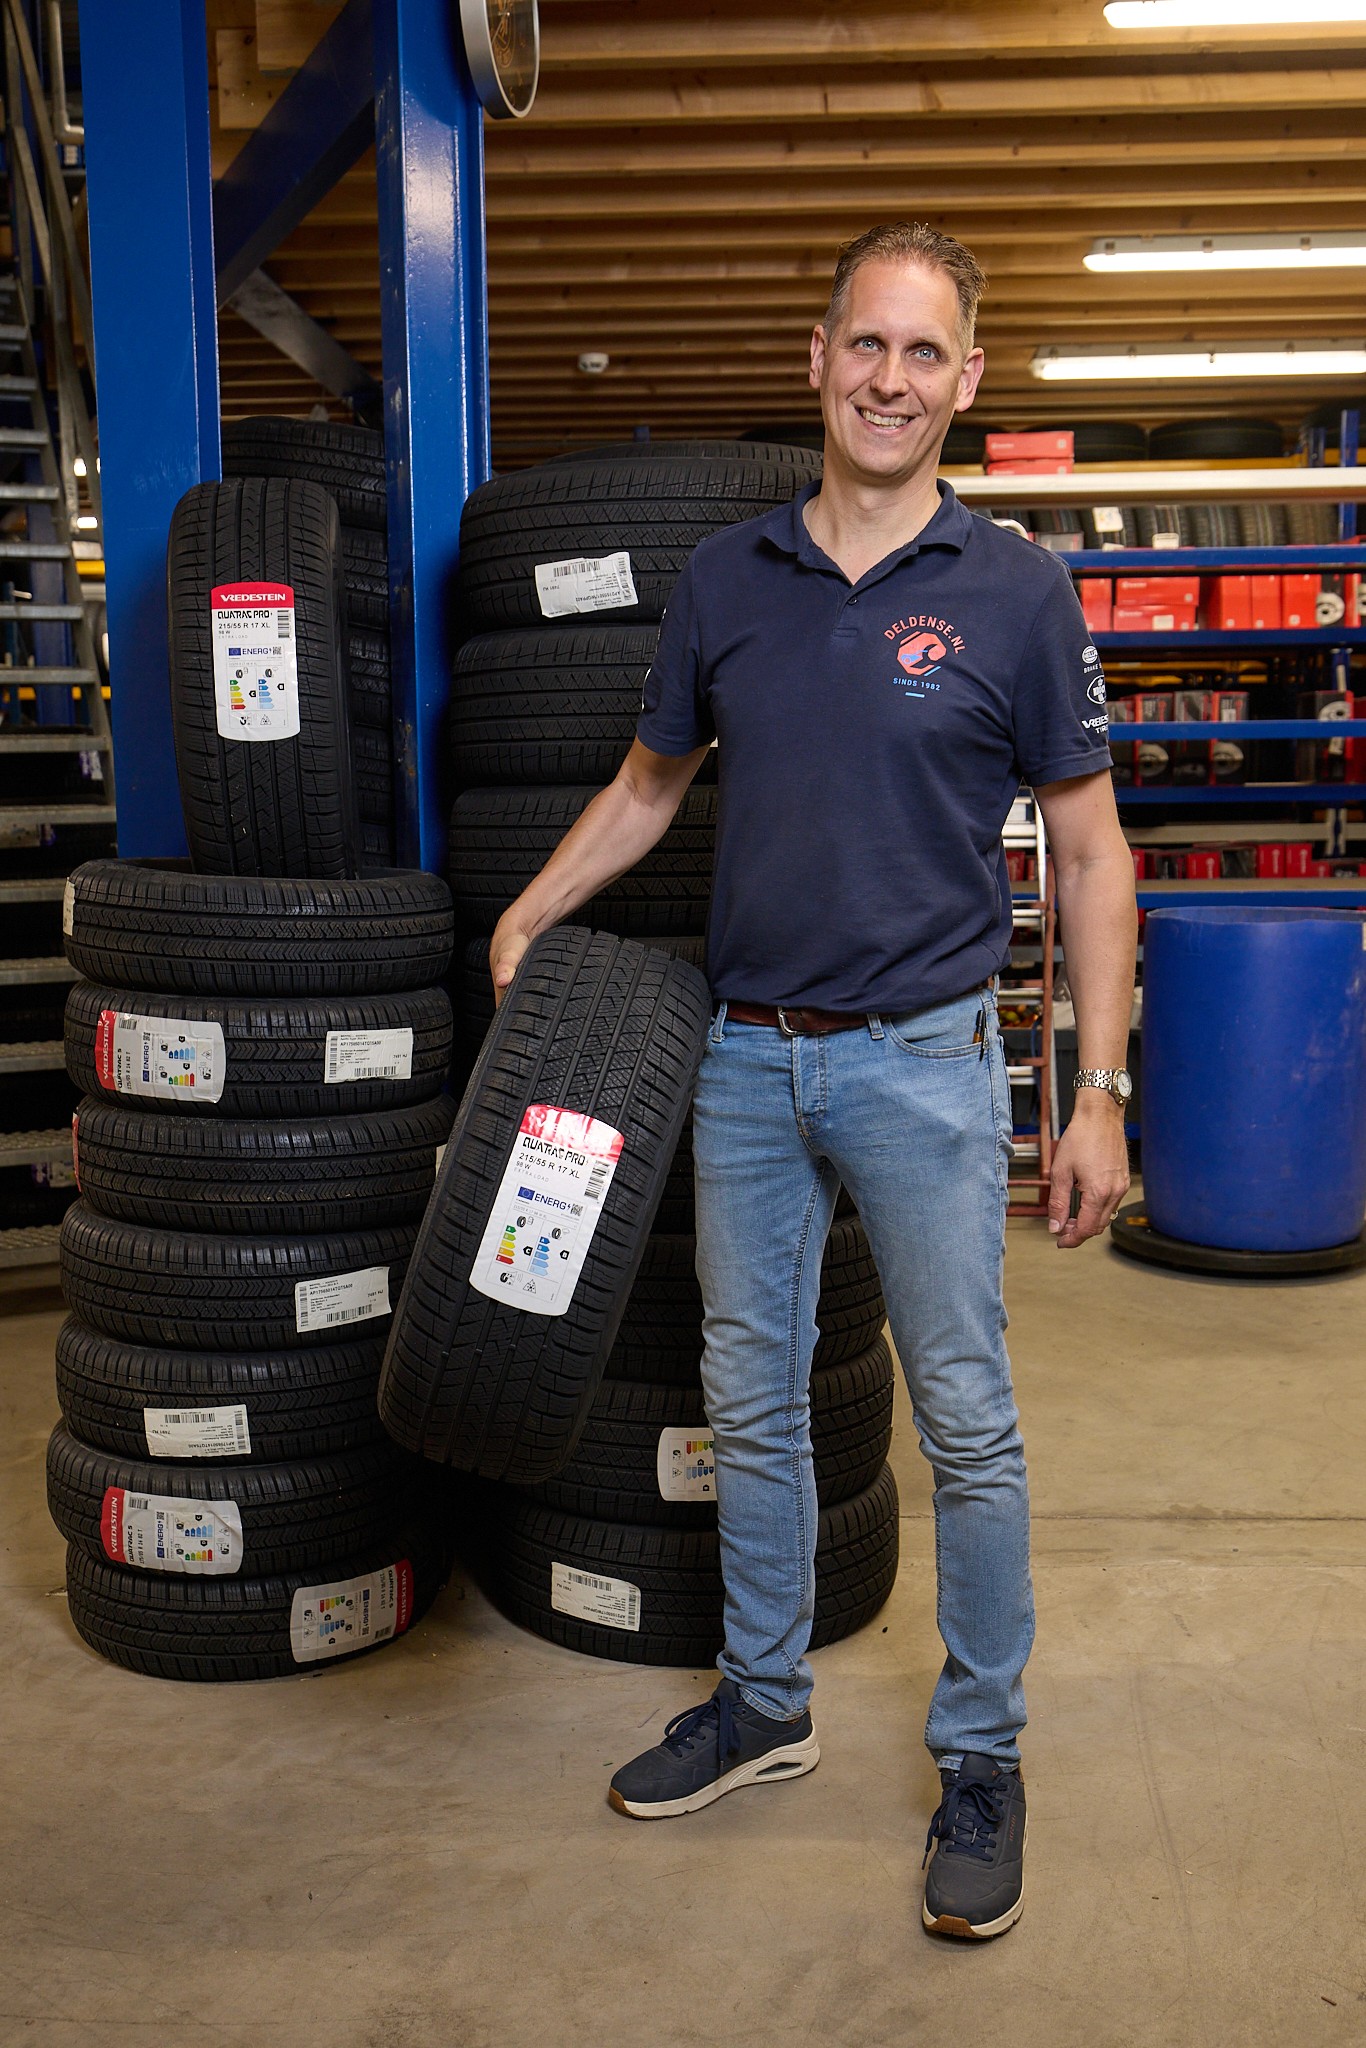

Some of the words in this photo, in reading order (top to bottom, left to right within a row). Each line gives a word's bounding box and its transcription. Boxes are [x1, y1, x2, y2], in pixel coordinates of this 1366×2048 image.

[220, 593, 286, 602] VREDESTEIN
[218, 610, 252, 619] QUATRAC
[884, 616, 966, 655] DELDENSE.NL
[1084, 664, 1098, 673] BRAKE
[893, 678, 917, 686] SINDS
[921, 682, 940, 691] 1982
[523, 1137, 564, 1159] QUATRAC
[519, 1153, 546, 1166] 215/55
[558, 1165, 567, 1173] 17
[570, 1169, 580, 1178] XL
[535, 1193, 567, 1210] ENERG
